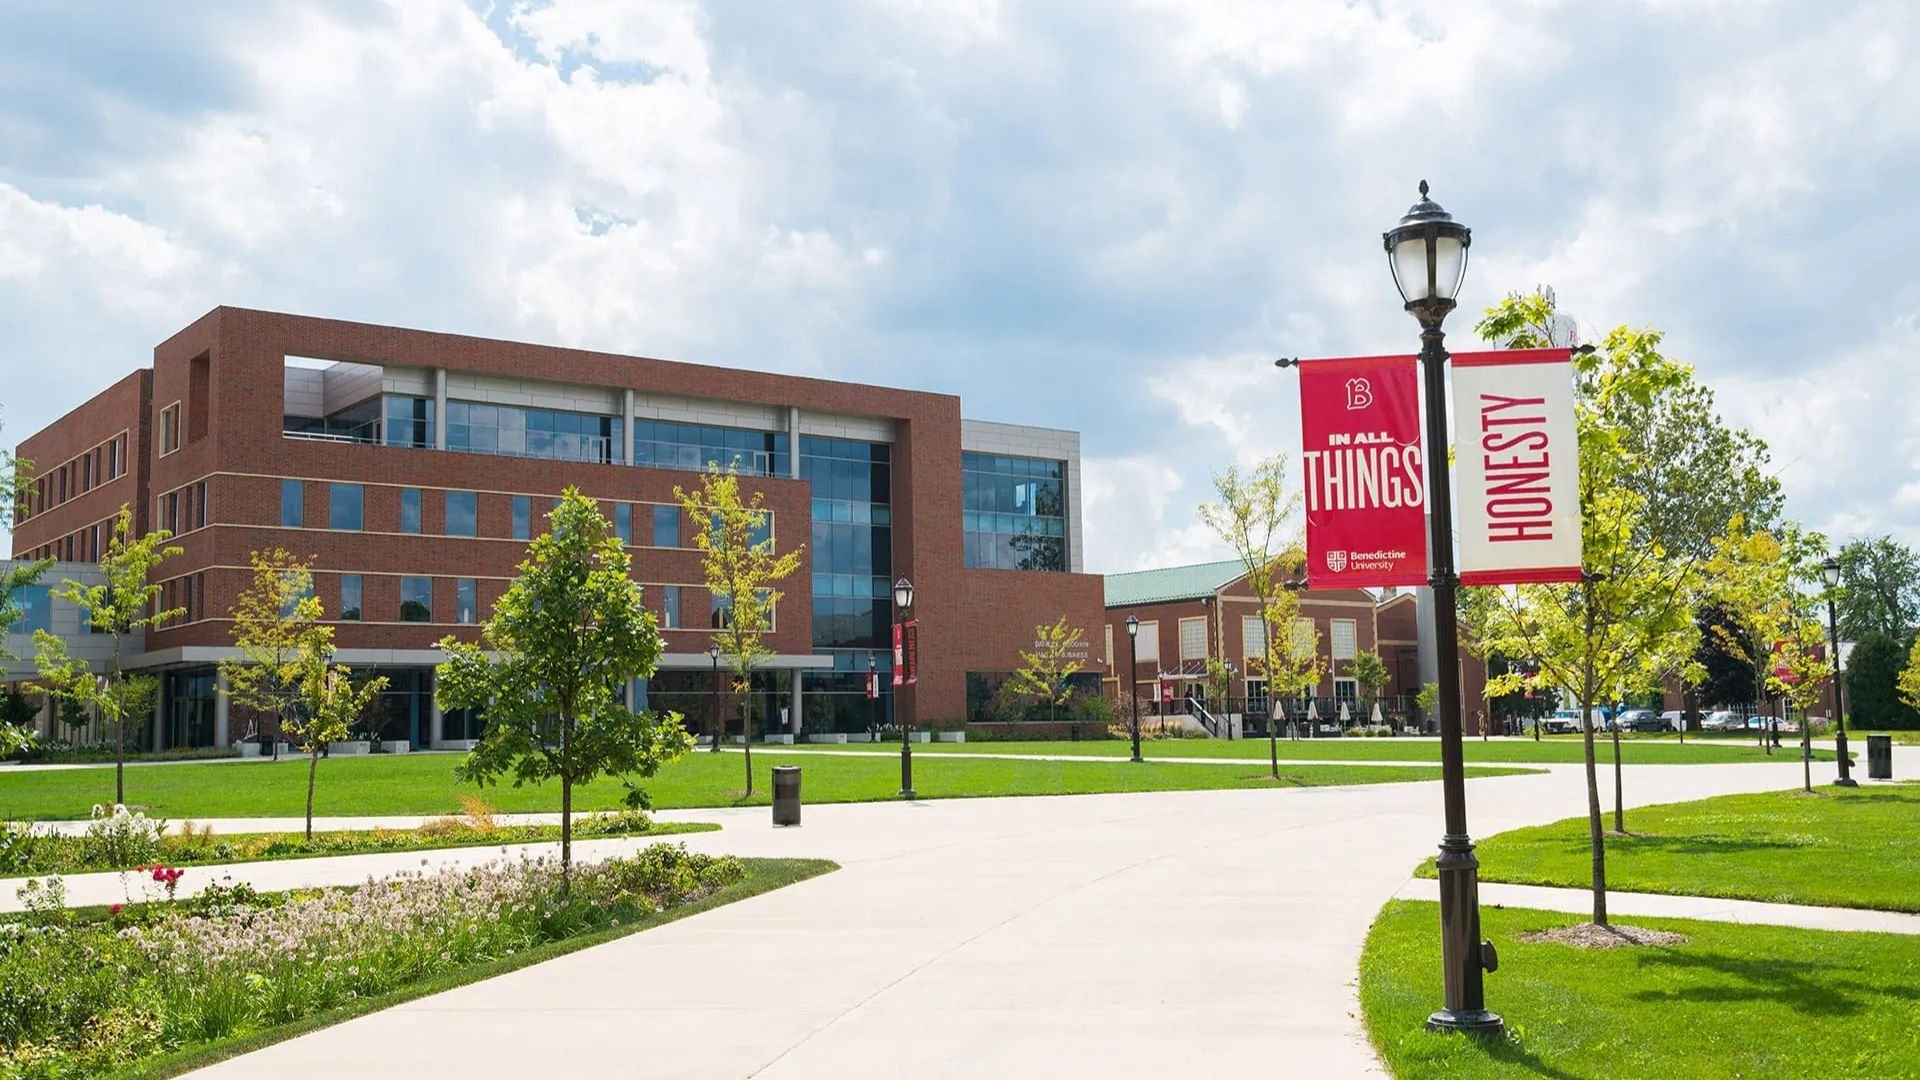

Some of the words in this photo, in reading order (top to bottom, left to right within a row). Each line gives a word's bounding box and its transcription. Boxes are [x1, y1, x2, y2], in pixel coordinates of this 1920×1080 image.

[1345, 377, 1373, 410] B
[1328, 433, 1350, 446] IN
[1353, 431, 1394, 445] ALL
[1303, 445, 1423, 511] THINGS
[1479, 393, 1553, 542] HONESTY
[1350, 550, 1406, 560] Benedictine
[1350, 560, 1394, 572] University
